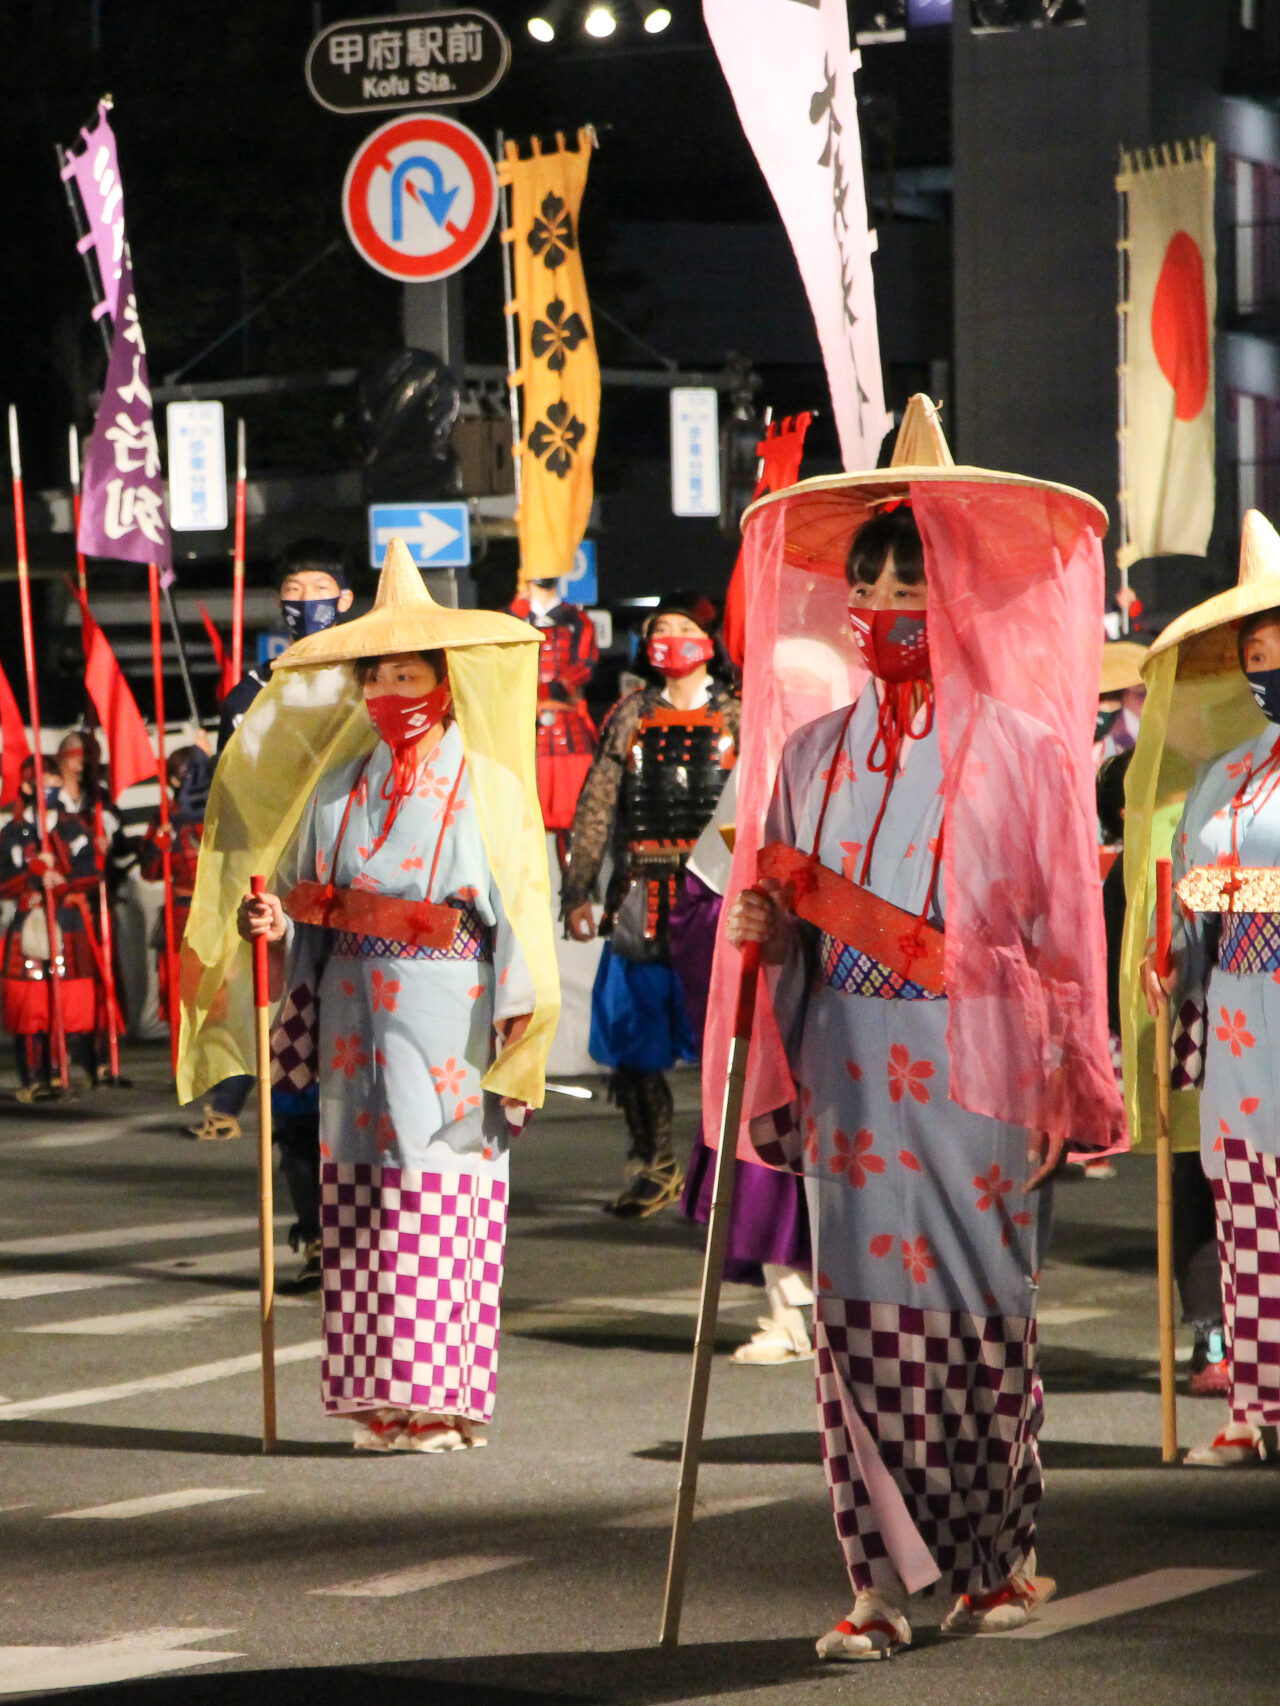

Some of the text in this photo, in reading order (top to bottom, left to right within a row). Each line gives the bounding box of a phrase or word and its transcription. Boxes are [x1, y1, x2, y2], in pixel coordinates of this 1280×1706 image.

[328, 23, 484, 75] 甲府駅前
[362, 72, 457, 99] Kofu Sta.
